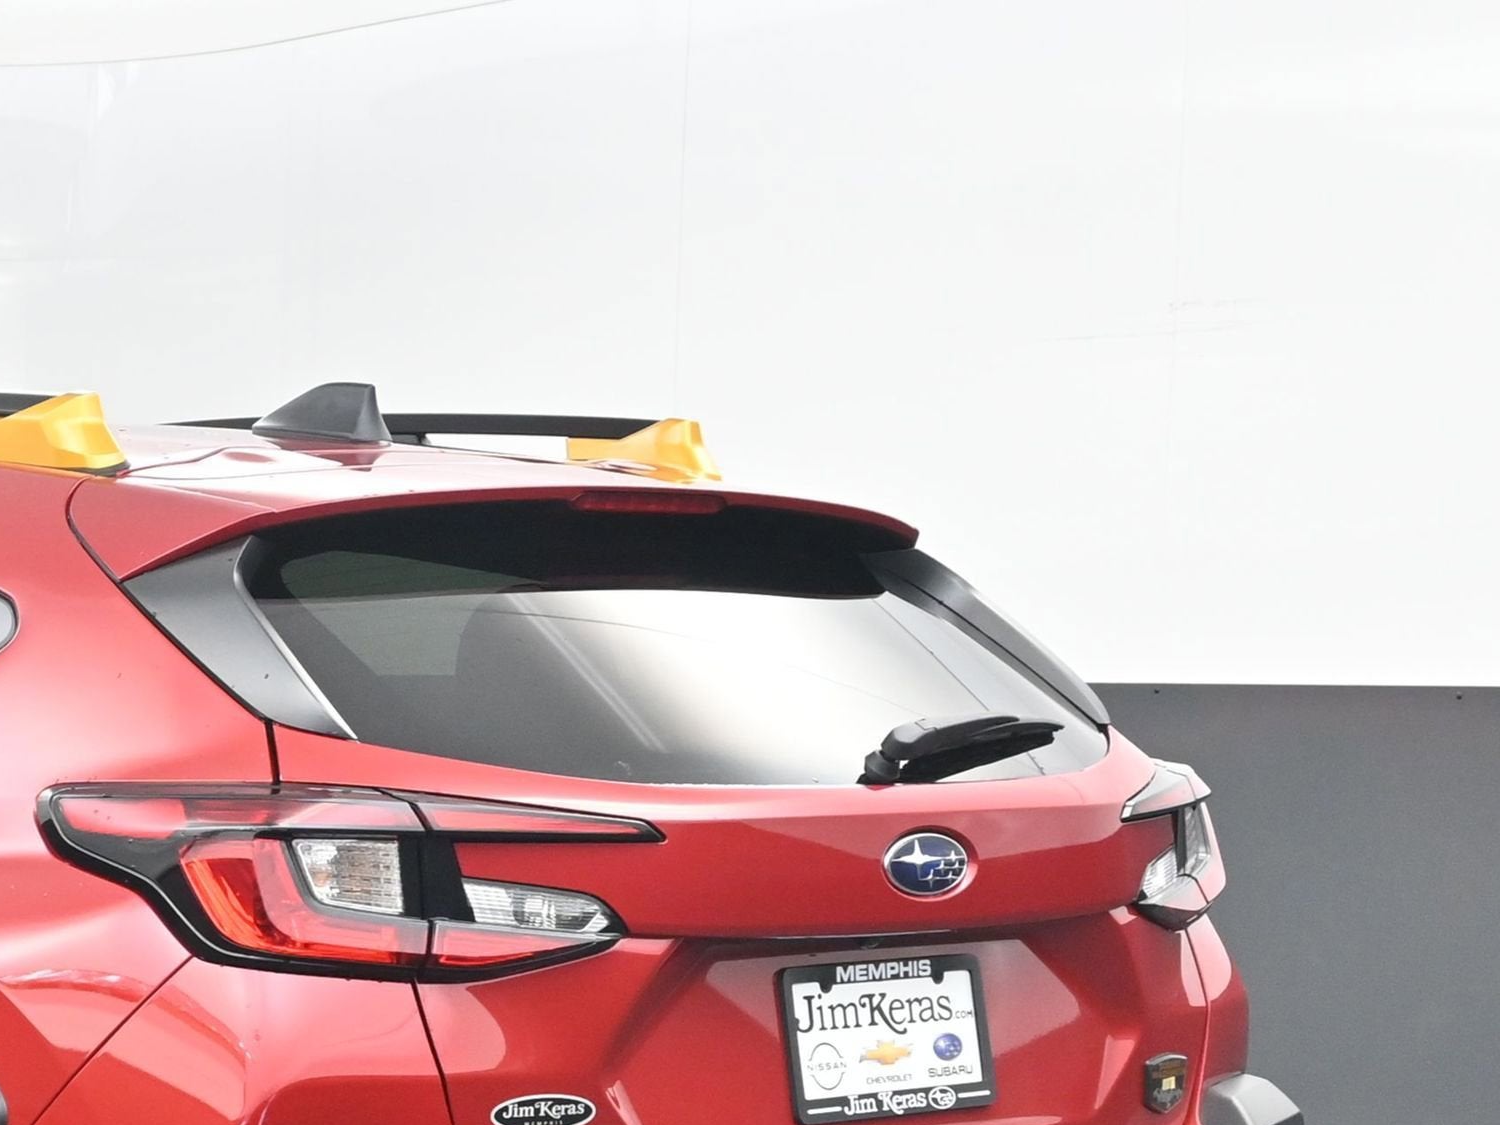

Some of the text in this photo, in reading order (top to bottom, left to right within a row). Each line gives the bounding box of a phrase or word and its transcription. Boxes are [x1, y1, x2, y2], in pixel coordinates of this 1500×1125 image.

[835, 959, 932, 983] MEMPHIS
[806, 1061, 847, 1072] NISSAN
[927, 1064, 973, 1078] SUBARU
[865, 1073, 912, 1085] CHEVROLET
